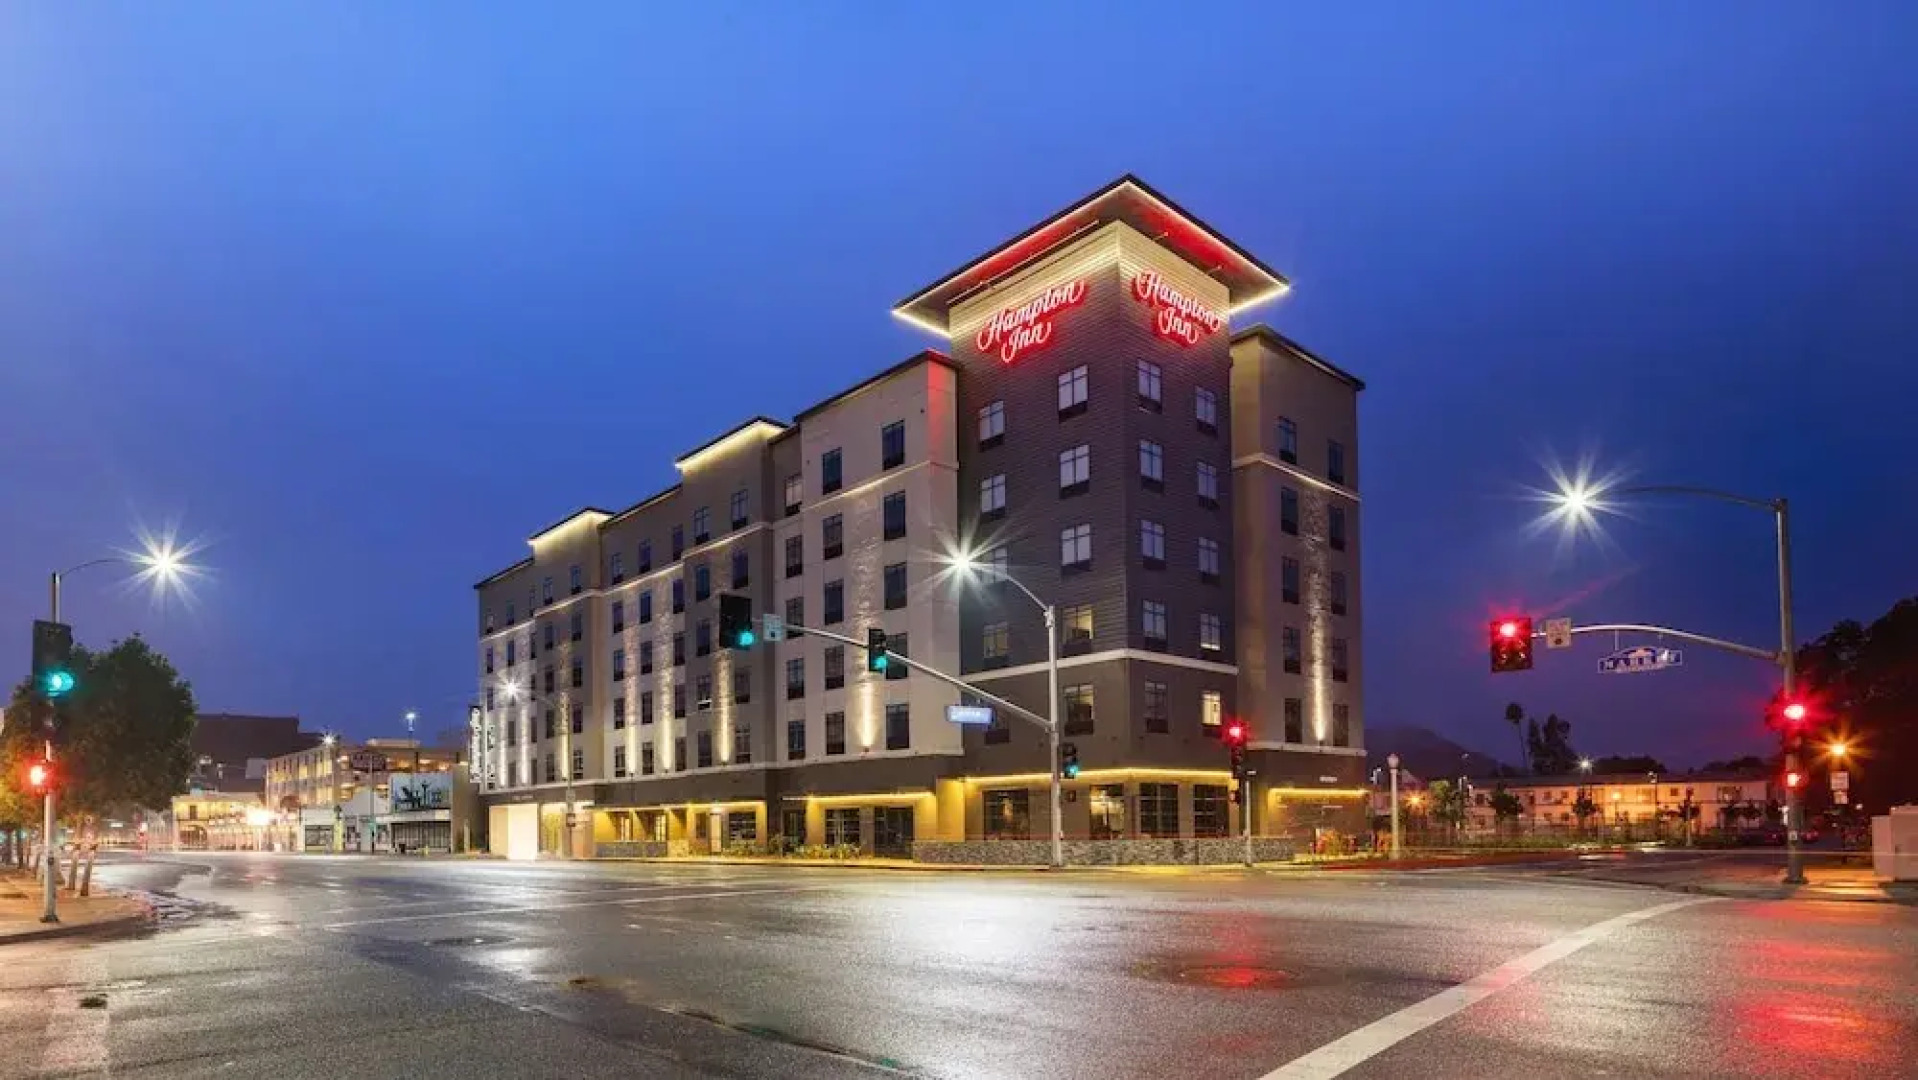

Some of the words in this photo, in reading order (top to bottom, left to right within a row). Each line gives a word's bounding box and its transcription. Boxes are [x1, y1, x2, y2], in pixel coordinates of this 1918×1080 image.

[977, 279, 1085, 351] Hampton
[1136, 270, 1221, 333] Hampton
[1158, 307, 1200, 344] Inn
[1001, 320, 1051, 363] Inn
